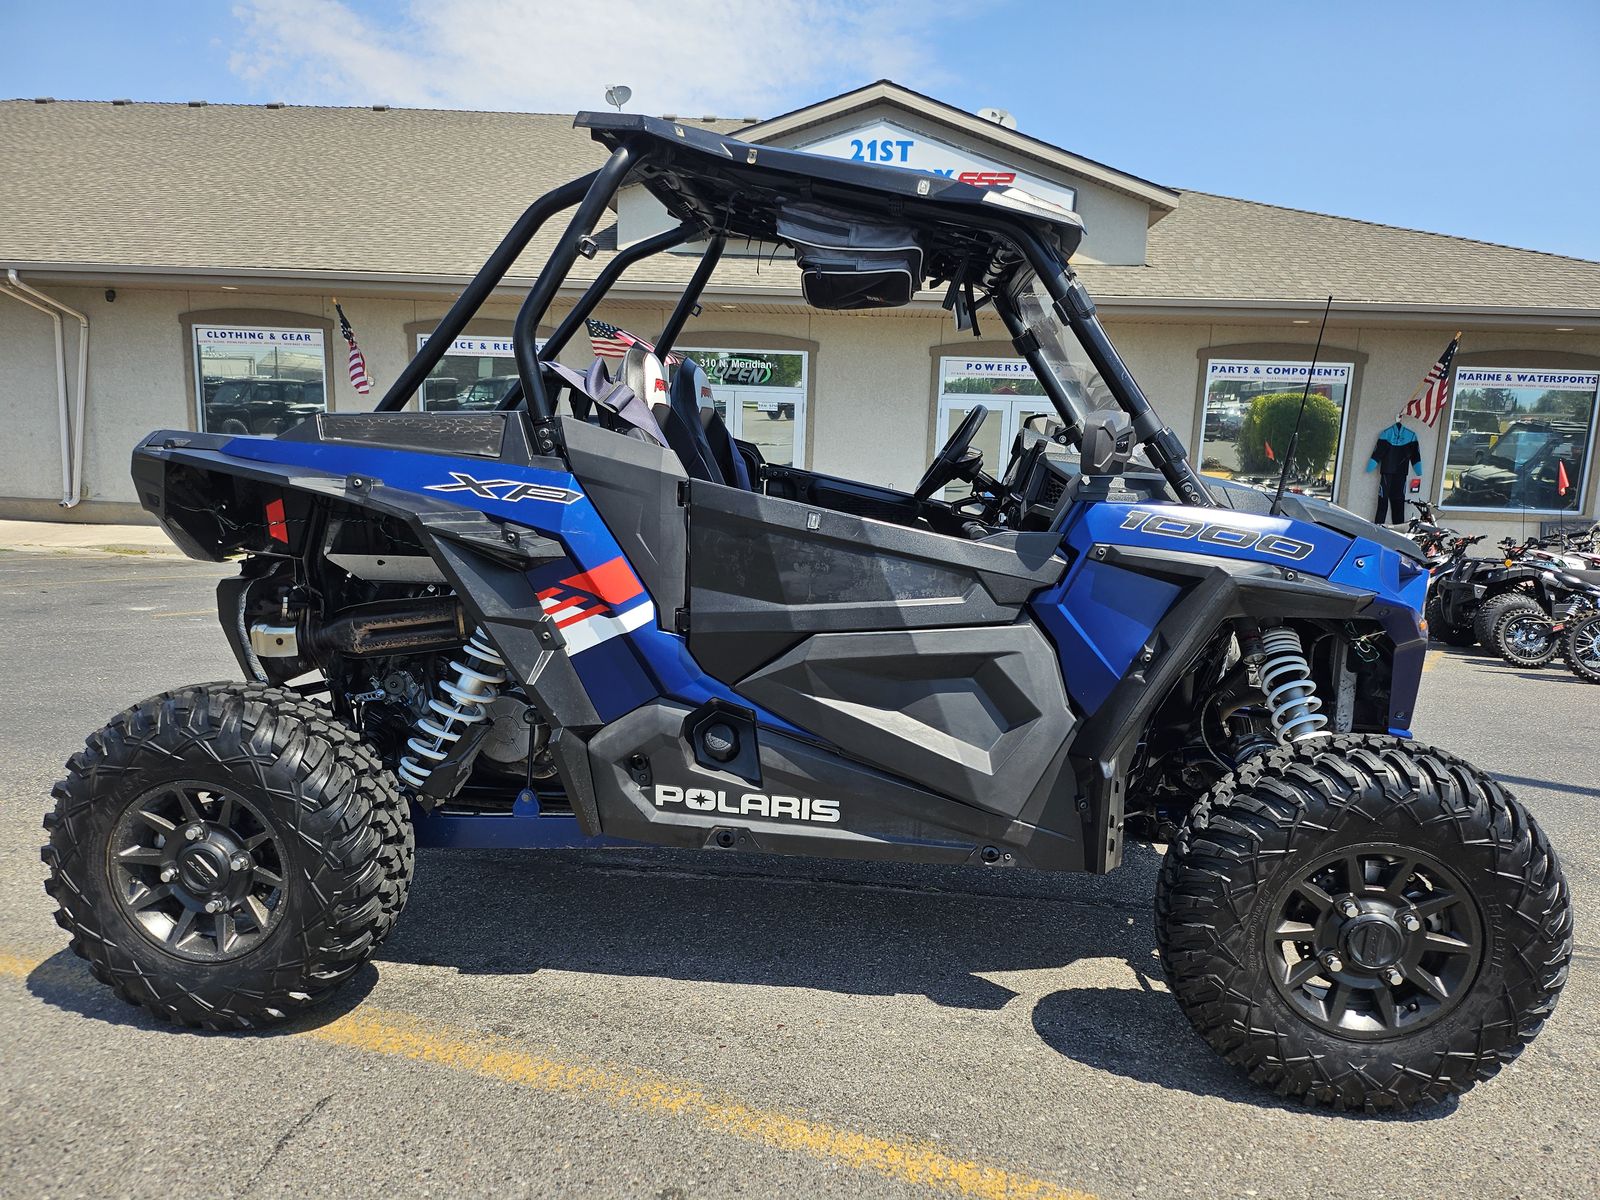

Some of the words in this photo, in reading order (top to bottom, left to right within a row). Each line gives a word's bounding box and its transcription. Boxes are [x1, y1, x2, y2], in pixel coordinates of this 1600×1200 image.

[850, 139, 914, 162] 21ST
[206, 331, 264, 340] CLOTHING
[269, 332, 277, 340] &
[281, 333, 312, 341] GEAR
[700, 358, 716, 367] 310
[720, 359, 728, 367] N.
[731, 360, 772, 369] Meridian
[1211, 365, 1249, 374] PARTS
[1266, 367, 1346, 376] COMPONENTS
[713, 364, 765, 384] OPEN
[1458, 372, 1501, 381] MARINE
[1517, 374, 1597, 384] WATERSPORTS
[423, 471, 585, 505] XP
[1120, 510, 1315, 561] 1000
[655, 784, 841, 823] POLARIS
